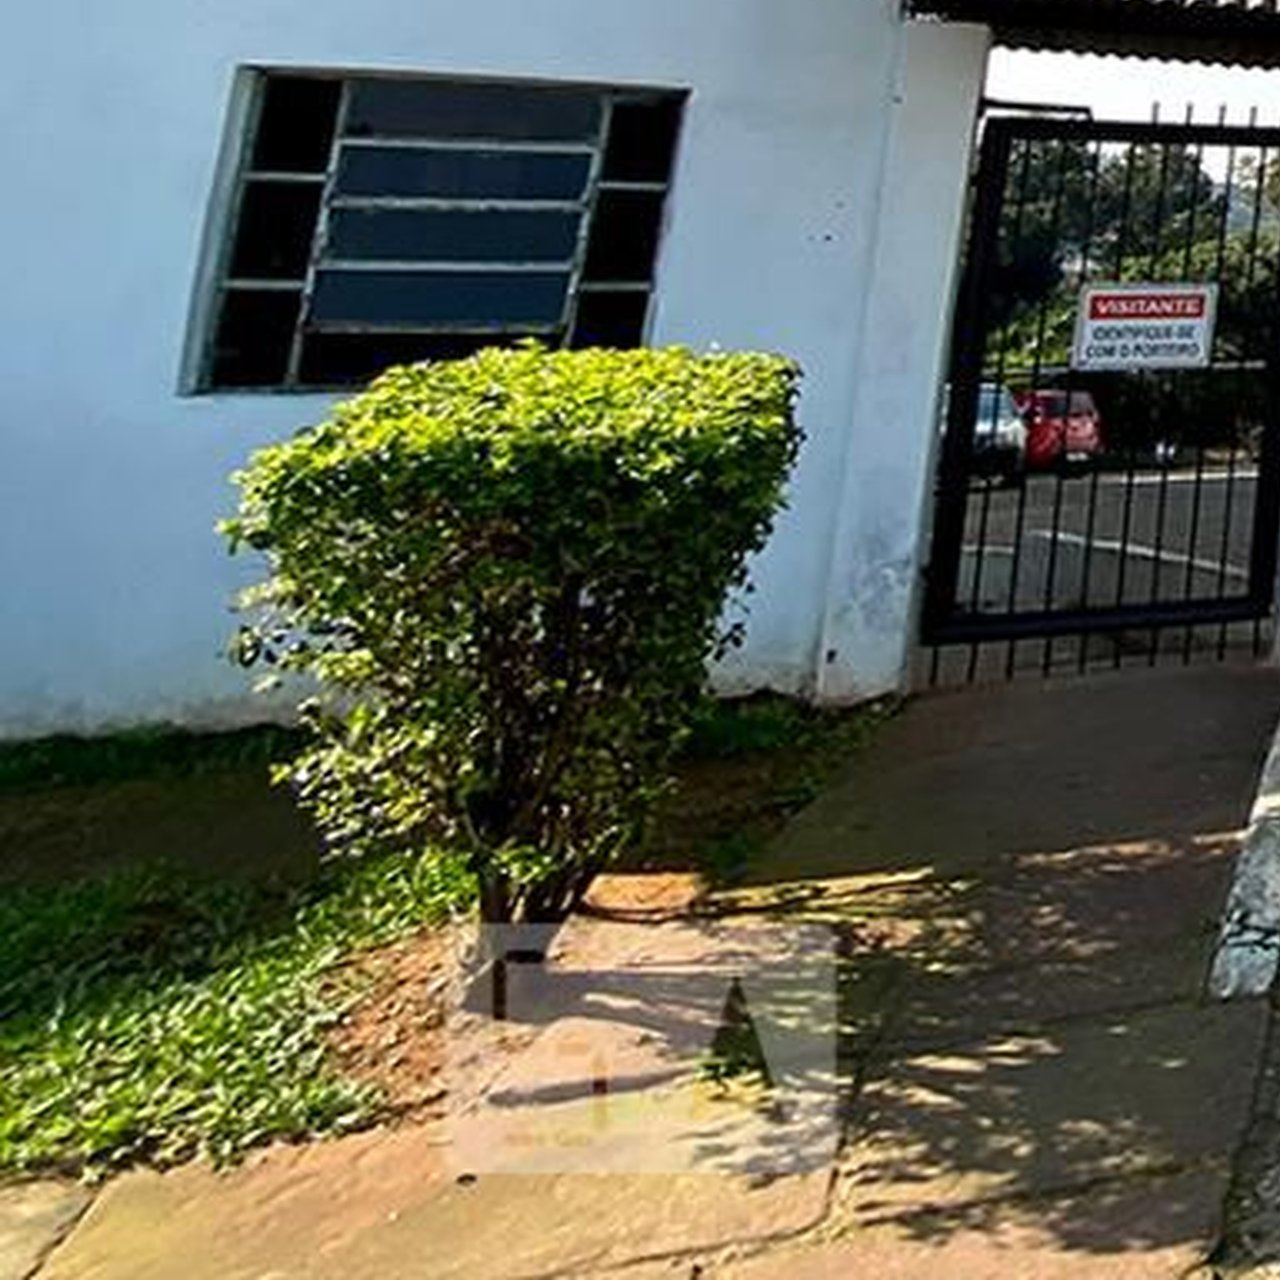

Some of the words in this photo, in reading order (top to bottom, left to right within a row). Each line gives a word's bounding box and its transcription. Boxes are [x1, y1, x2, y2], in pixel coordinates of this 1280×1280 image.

[1096, 298, 1200, 314] VISITANTE
[1086, 344, 1116, 358] COM
[1120, 344, 1131, 358] O
[1133, 343, 1200, 358] PORTEIRO
